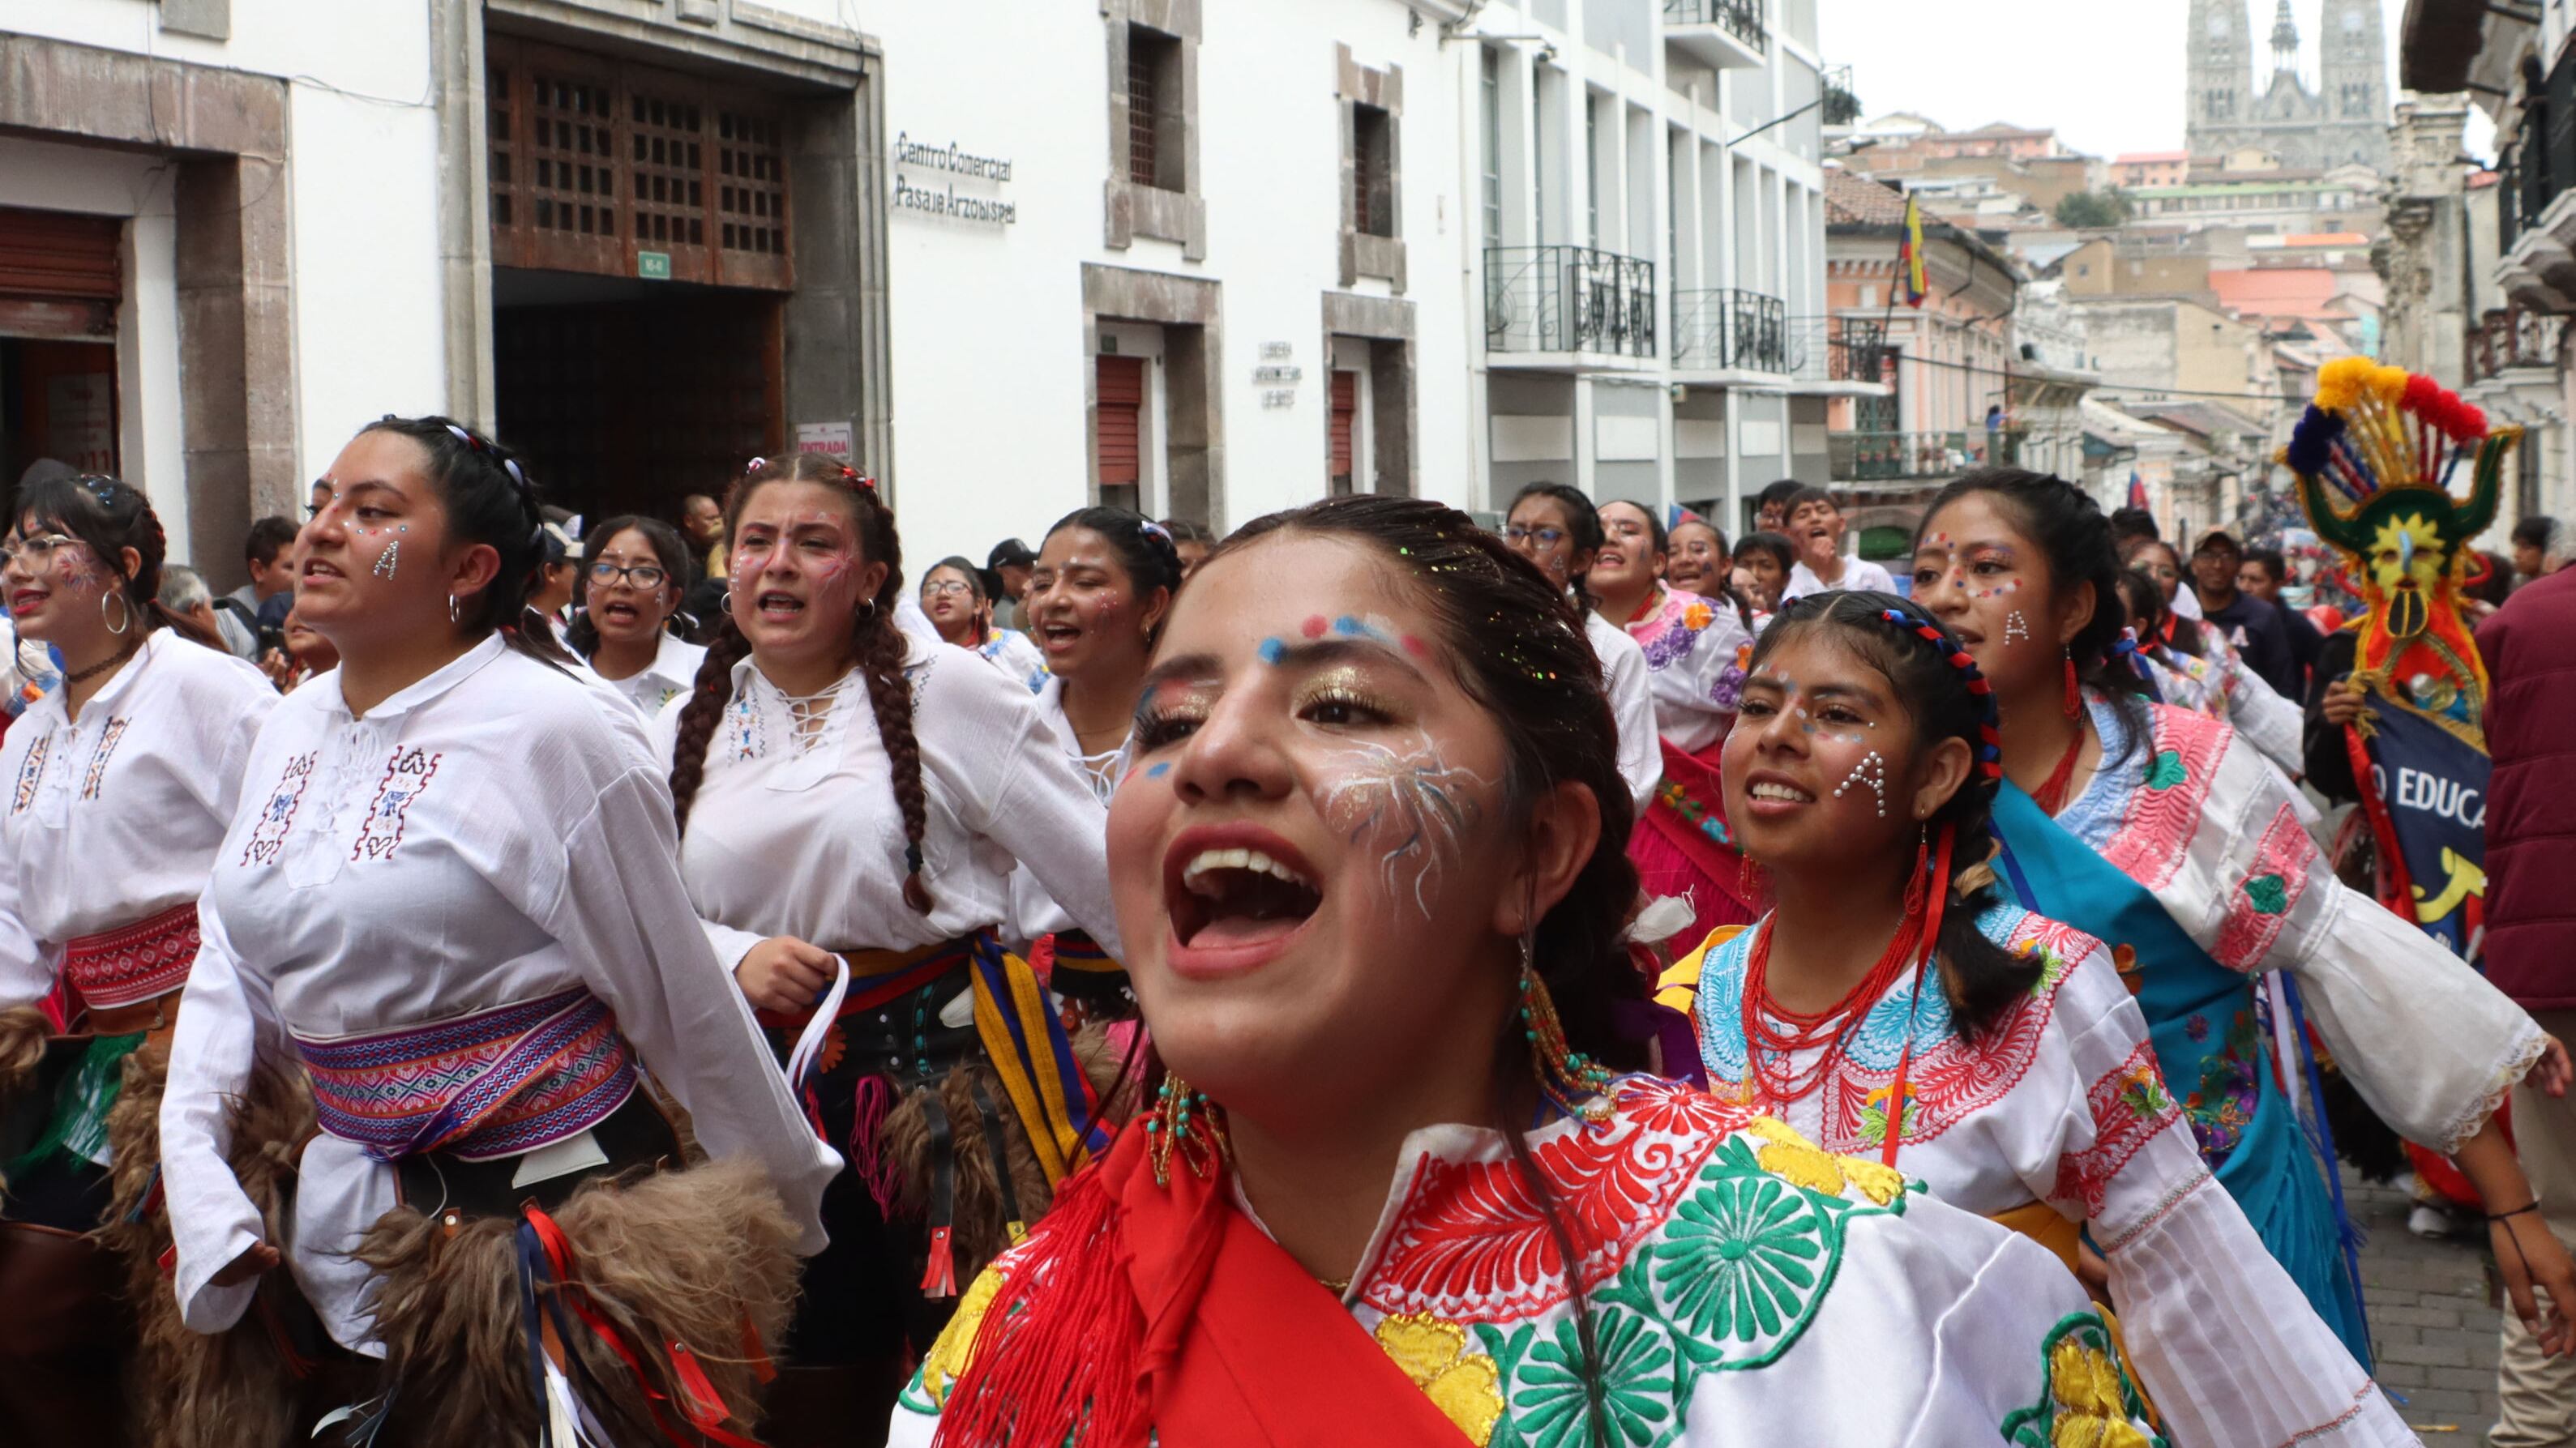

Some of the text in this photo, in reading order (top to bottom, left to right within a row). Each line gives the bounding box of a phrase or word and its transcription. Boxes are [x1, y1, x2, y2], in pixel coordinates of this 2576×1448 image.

[897, 130, 1012, 182] Centro Comercial
[896, 173, 944, 214] Pasaje
[798, 440, 847, 455] ENTRADA
